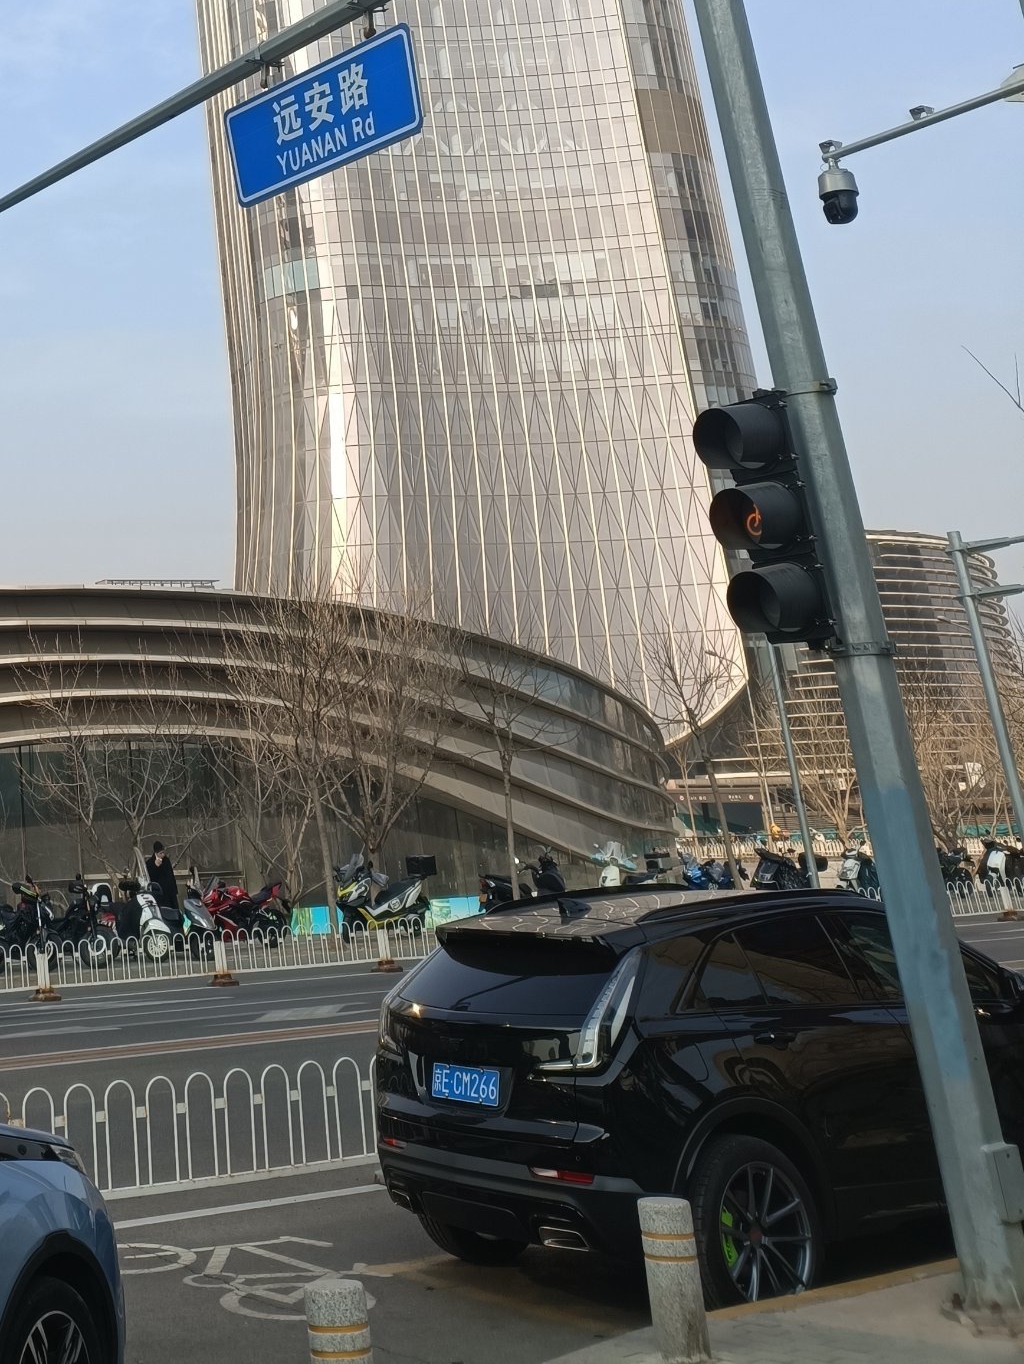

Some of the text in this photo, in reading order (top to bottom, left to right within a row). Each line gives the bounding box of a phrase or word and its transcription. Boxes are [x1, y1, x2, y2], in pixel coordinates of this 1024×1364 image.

[273, 63, 368, 145] 远安路
[276, 111, 376, 175] YUANAN Rd
